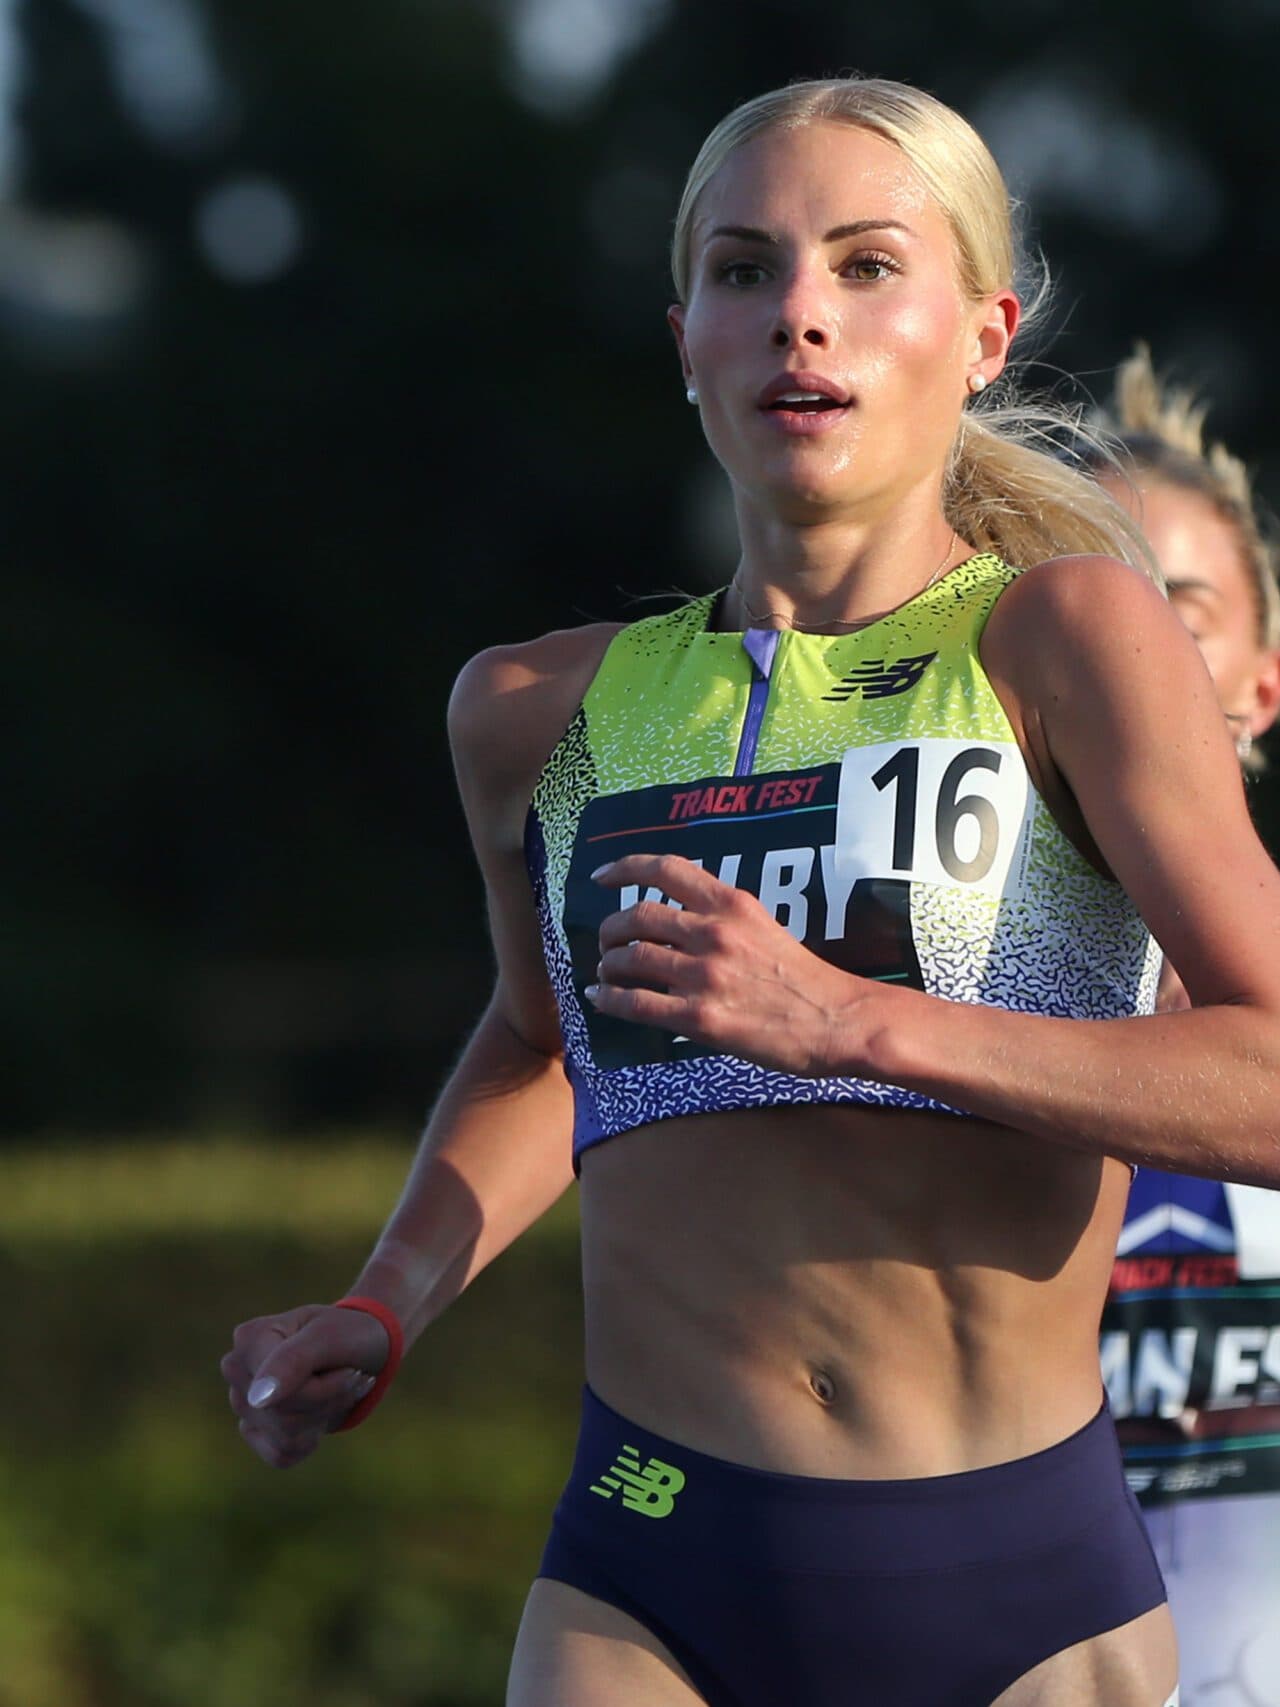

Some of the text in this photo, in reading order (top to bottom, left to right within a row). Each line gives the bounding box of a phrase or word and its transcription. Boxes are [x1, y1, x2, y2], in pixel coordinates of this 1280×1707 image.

[667, 775, 823, 821] TRACK FEST
[870, 745, 1004, 885] 16
